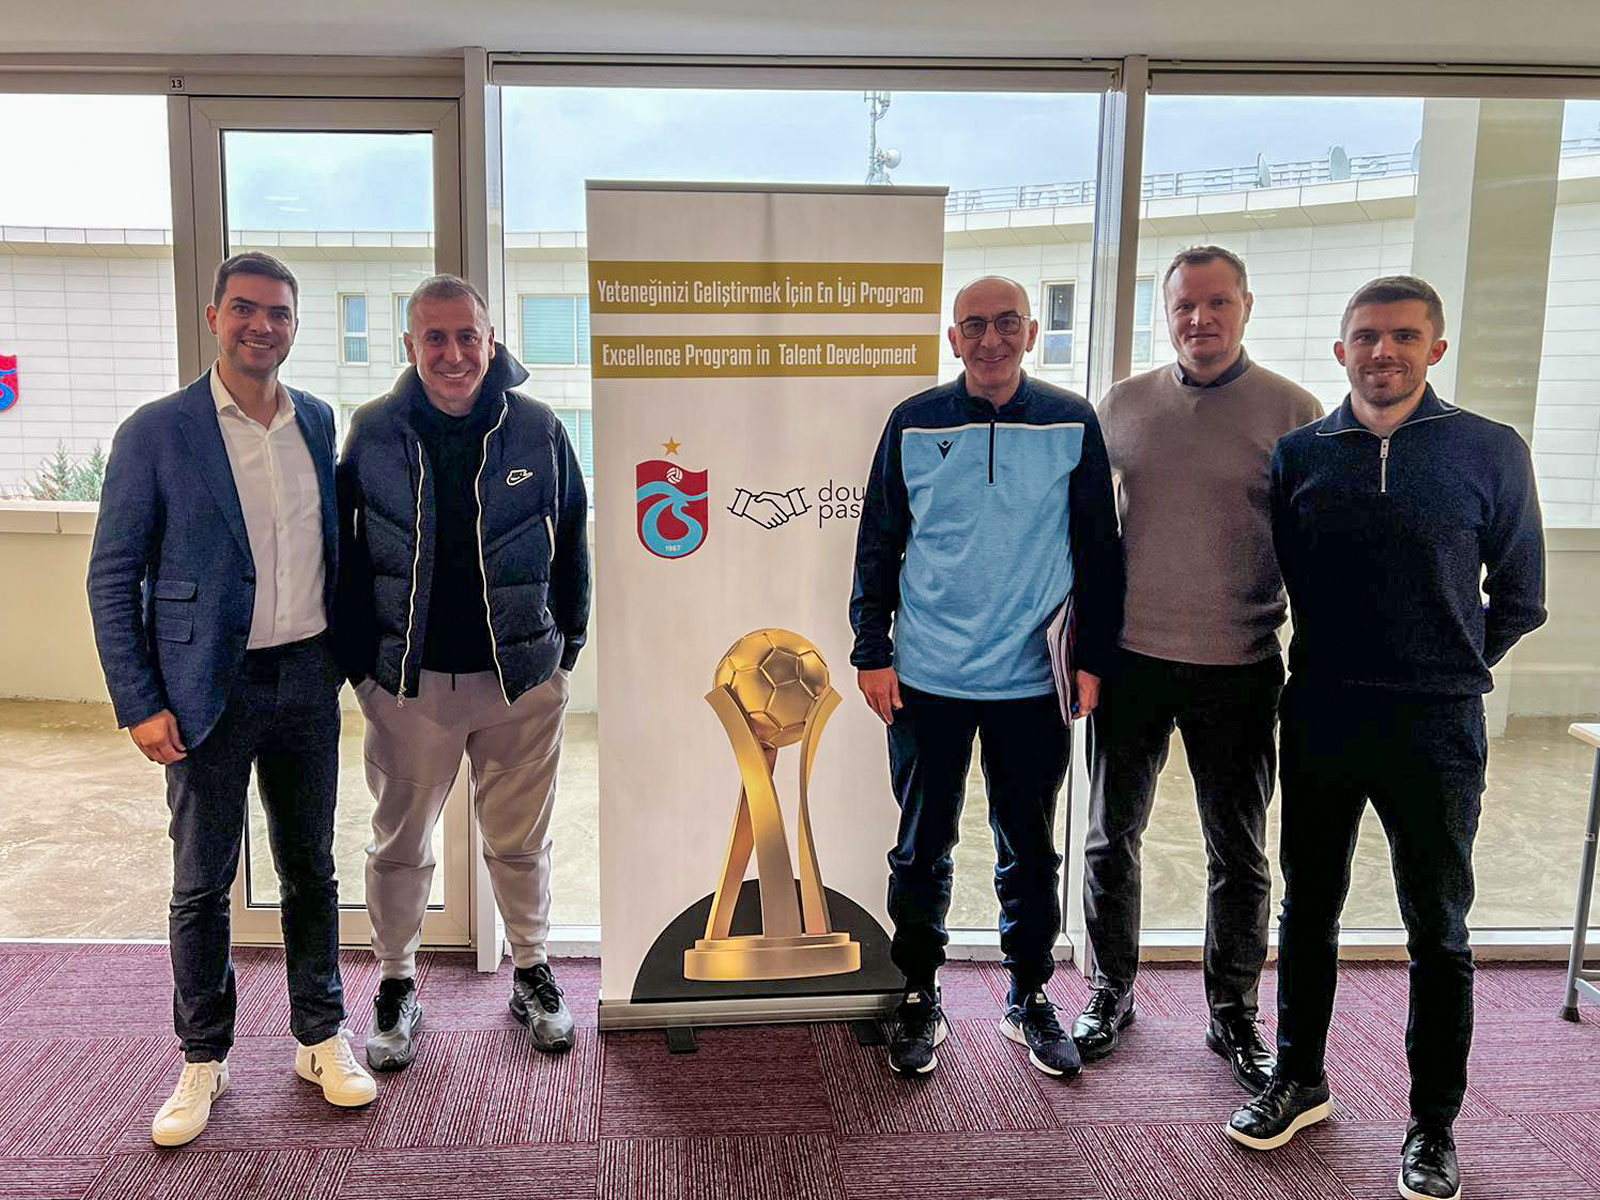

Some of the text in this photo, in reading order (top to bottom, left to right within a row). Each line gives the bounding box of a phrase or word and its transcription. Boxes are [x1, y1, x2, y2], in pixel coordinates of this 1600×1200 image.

[171, 79, 183, 88] 13
[597, 276, 924, 308] Yeteneğinizi Geliştirmek İçin En İyi Program
[602, 343, 917, 369] Excellence Program in Talent Development
[818, 479, 865, 502] dou
[819, 503, 861, 529] pas
[665, 544, 681, 552] 1967
